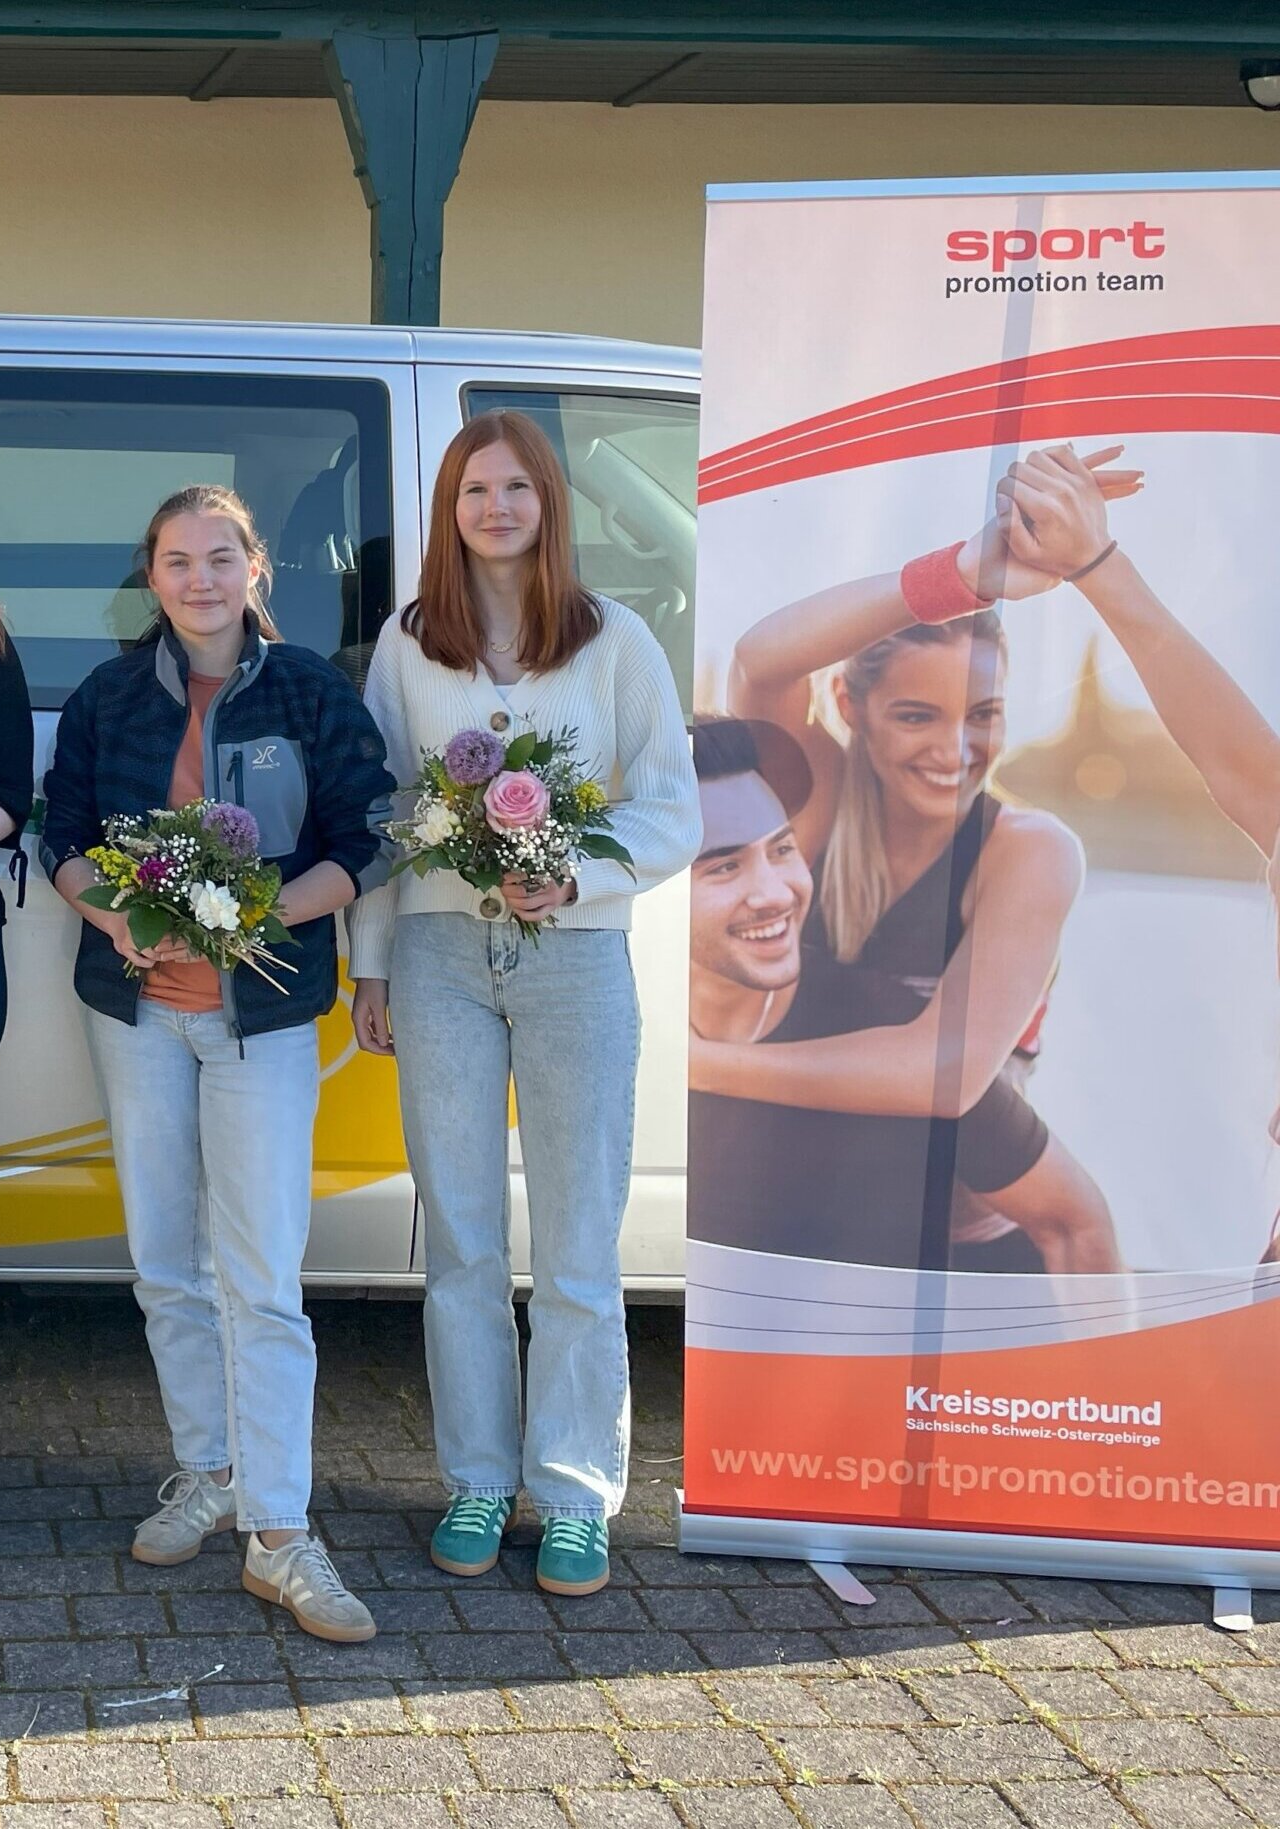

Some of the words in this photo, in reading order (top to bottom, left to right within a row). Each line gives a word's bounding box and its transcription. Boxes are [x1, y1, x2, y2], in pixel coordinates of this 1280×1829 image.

[946, 221, 1165, 272] sport
[946, 272, 1087, 299] promotion
[1097, 271, 1164, 291] team
[905, 1385, 1162, 1426] Kreissportbund
[905, 1417, 989, 1436] Sächsische
[991, 1423, 1161, 1448] Schweiz-Osterzgebirge
